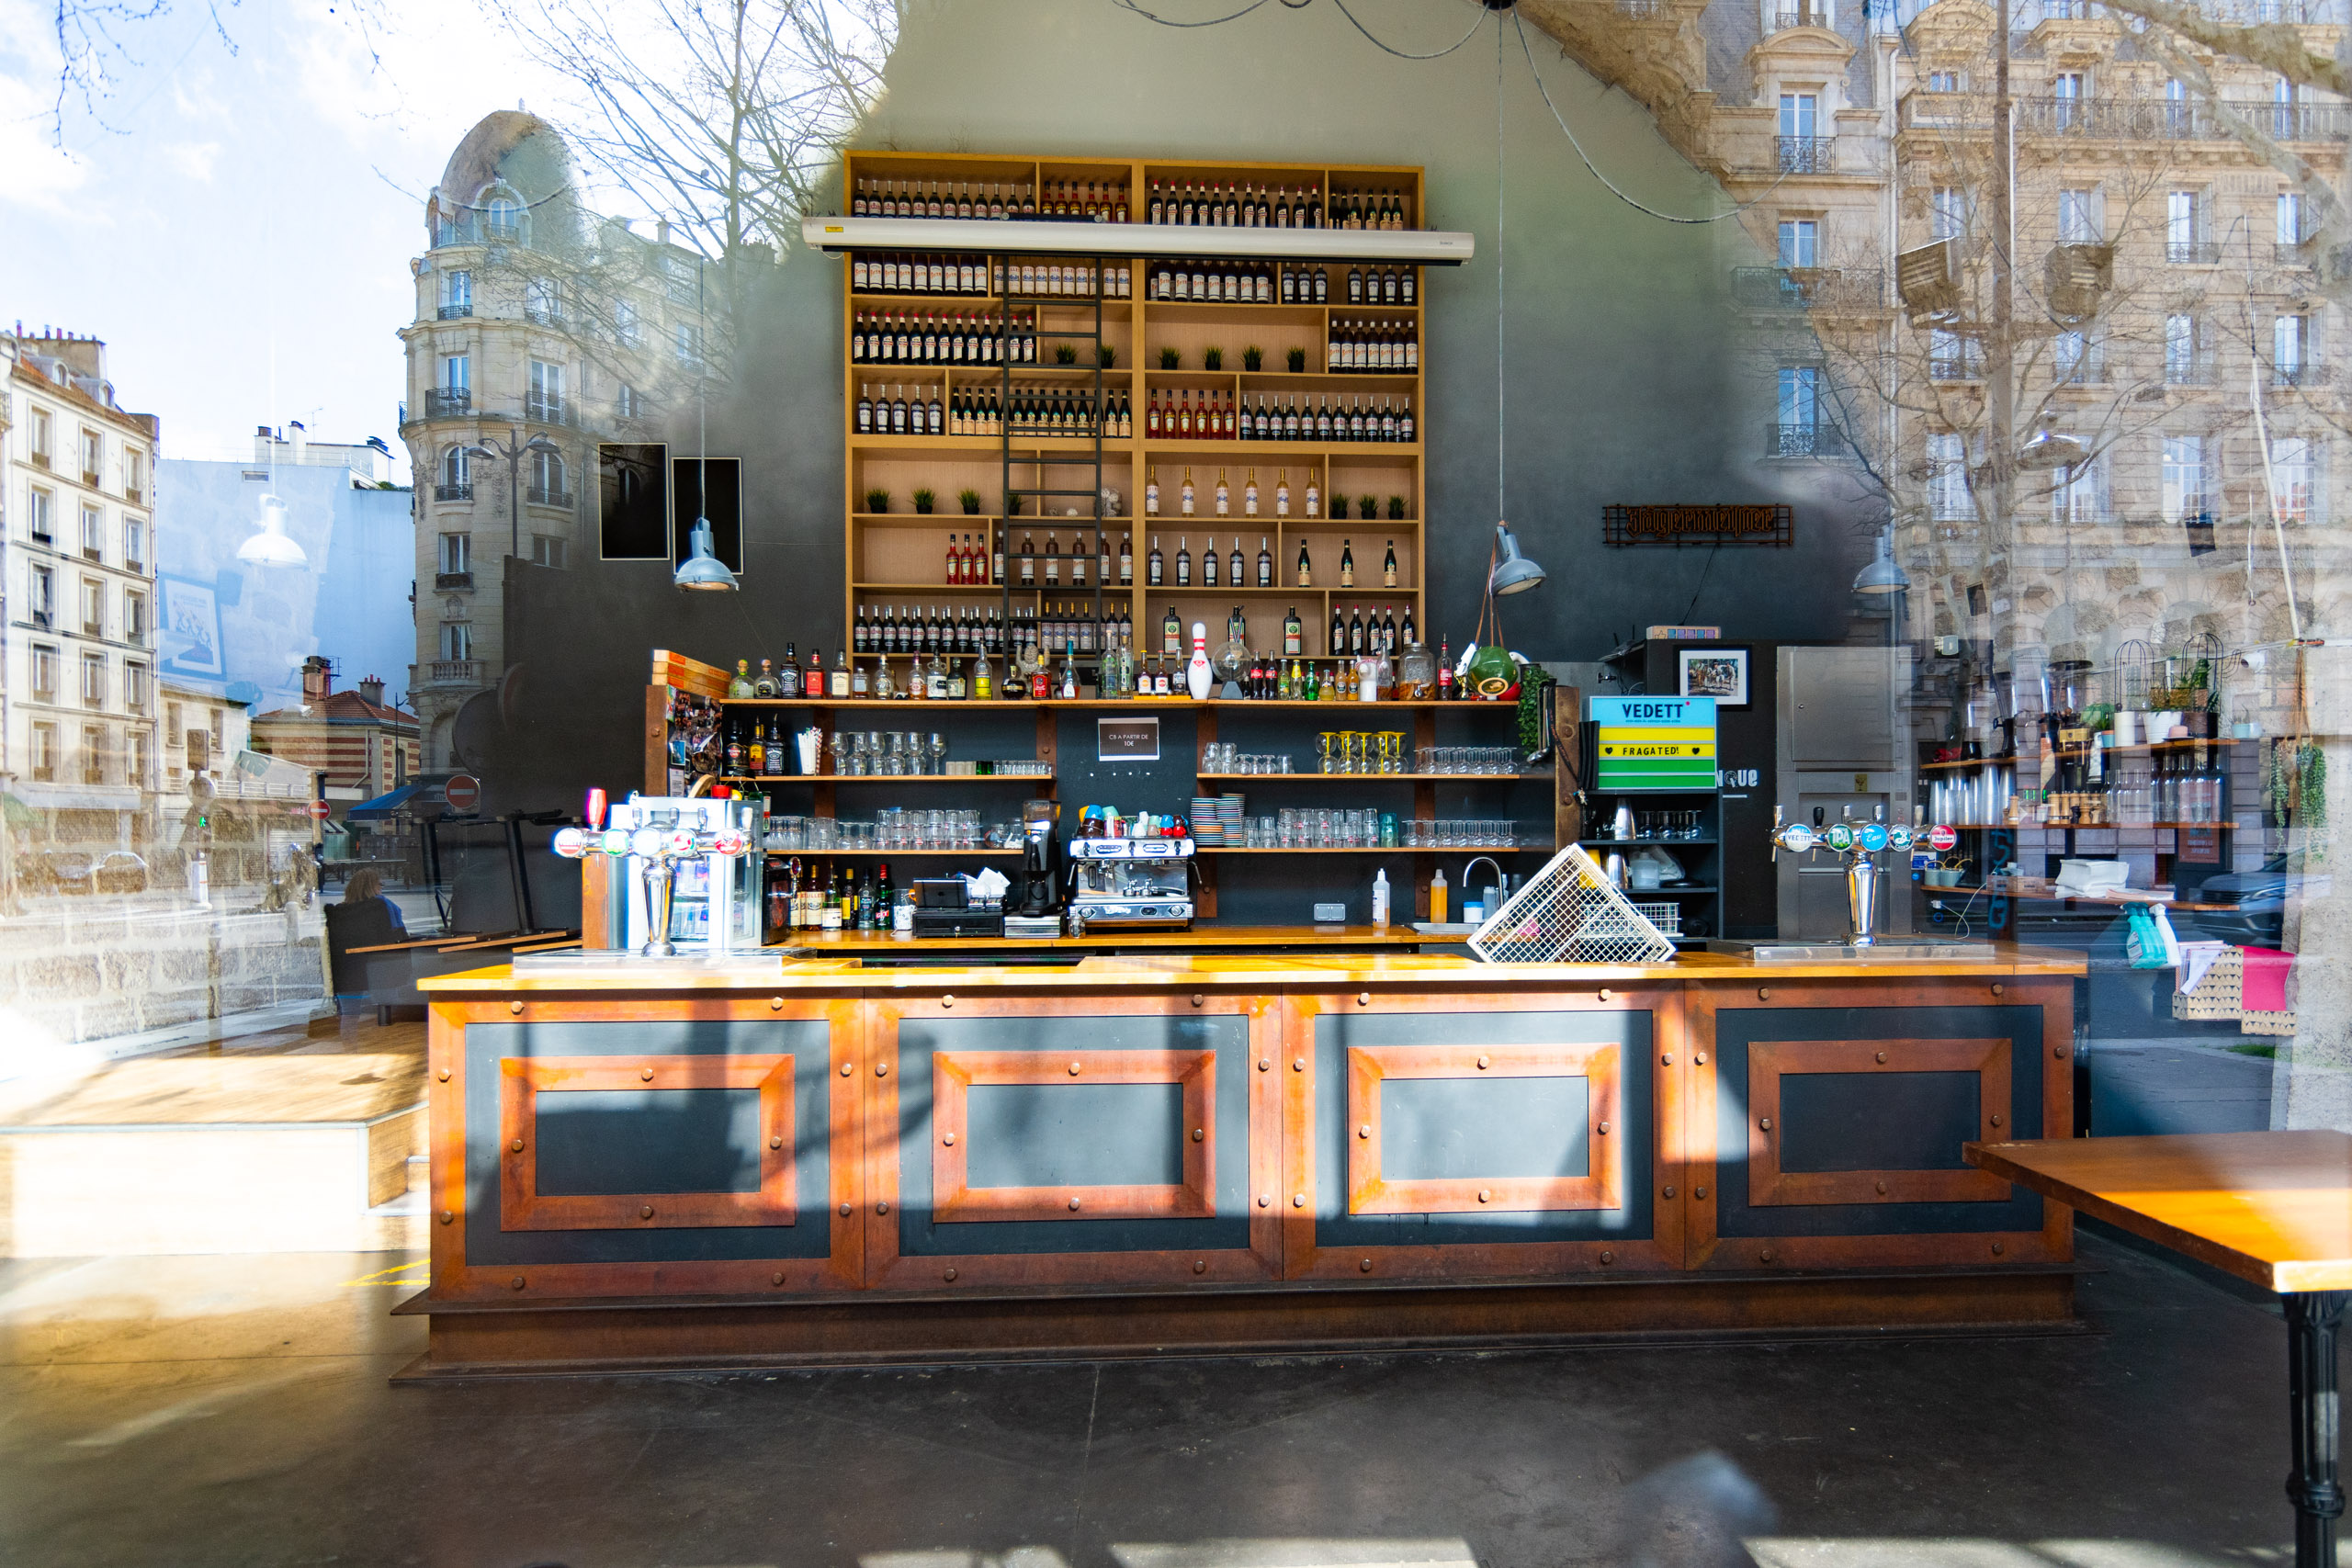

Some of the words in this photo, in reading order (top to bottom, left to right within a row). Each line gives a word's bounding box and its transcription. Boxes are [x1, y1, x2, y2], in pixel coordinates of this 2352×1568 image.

[1622, 704, 1684, 718] VEDETT
[1623, 746, 1679, 756] FRAGATED!
[1831, 828, 1851, 845] IPA
[1866, 833, 1883, 842] Eau
[1933, 835, 1953, 843] Jupiler
